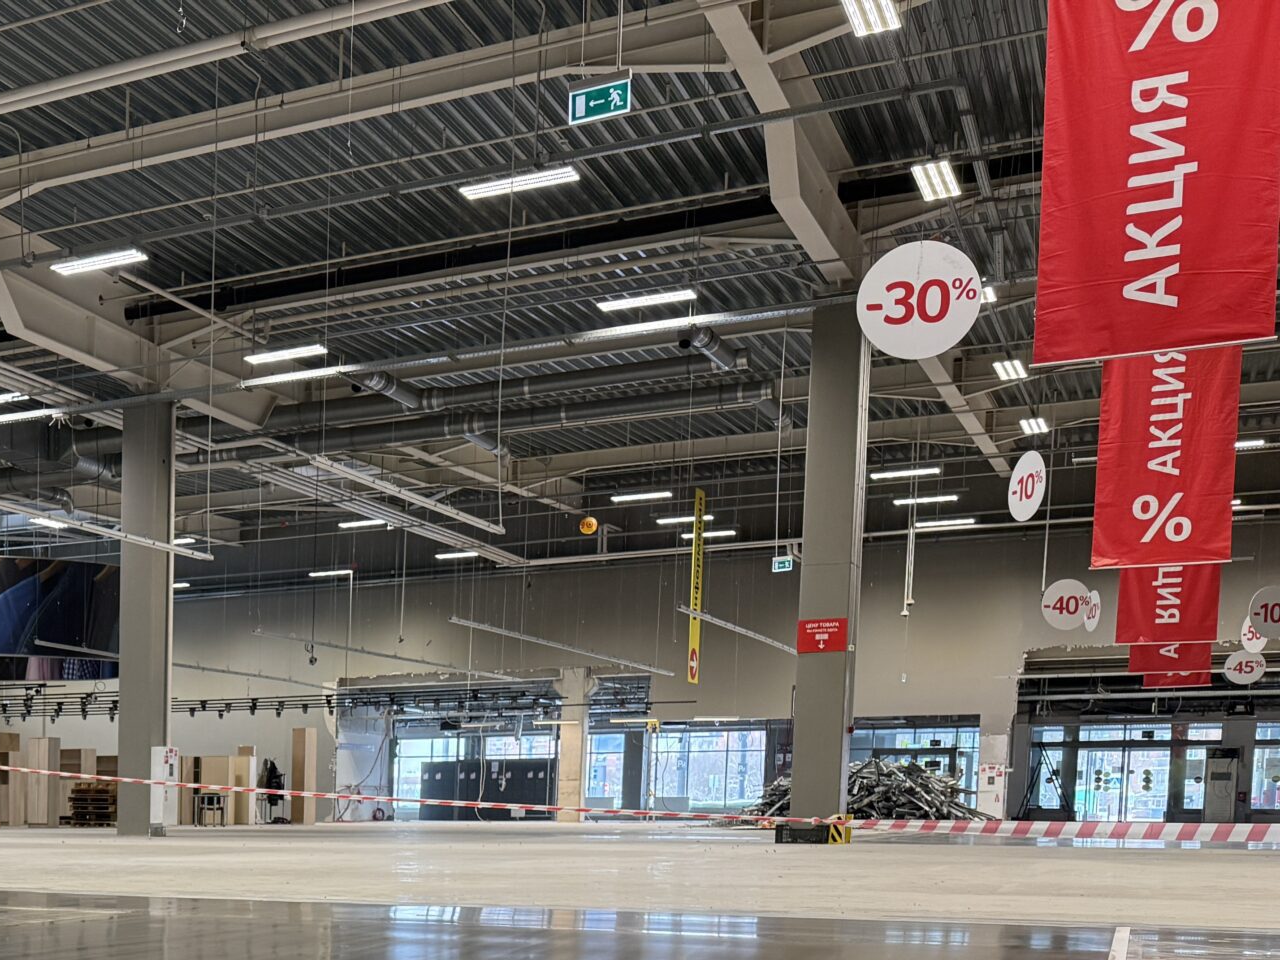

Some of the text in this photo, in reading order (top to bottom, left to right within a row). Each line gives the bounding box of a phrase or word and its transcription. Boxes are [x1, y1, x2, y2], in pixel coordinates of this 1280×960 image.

[1123, 71, 1199, 308] АКЦИЯ
[865, 276, 977, 326] -30%
[1011, 469, 1043, 502] -10%
[1043, 595, 1090, 615] -40%
[1152, 566, 1183, 624] ЦИЯ
[1253, 603, 1280, 624] -10
[1227, 660, 1265, 674] -45%
